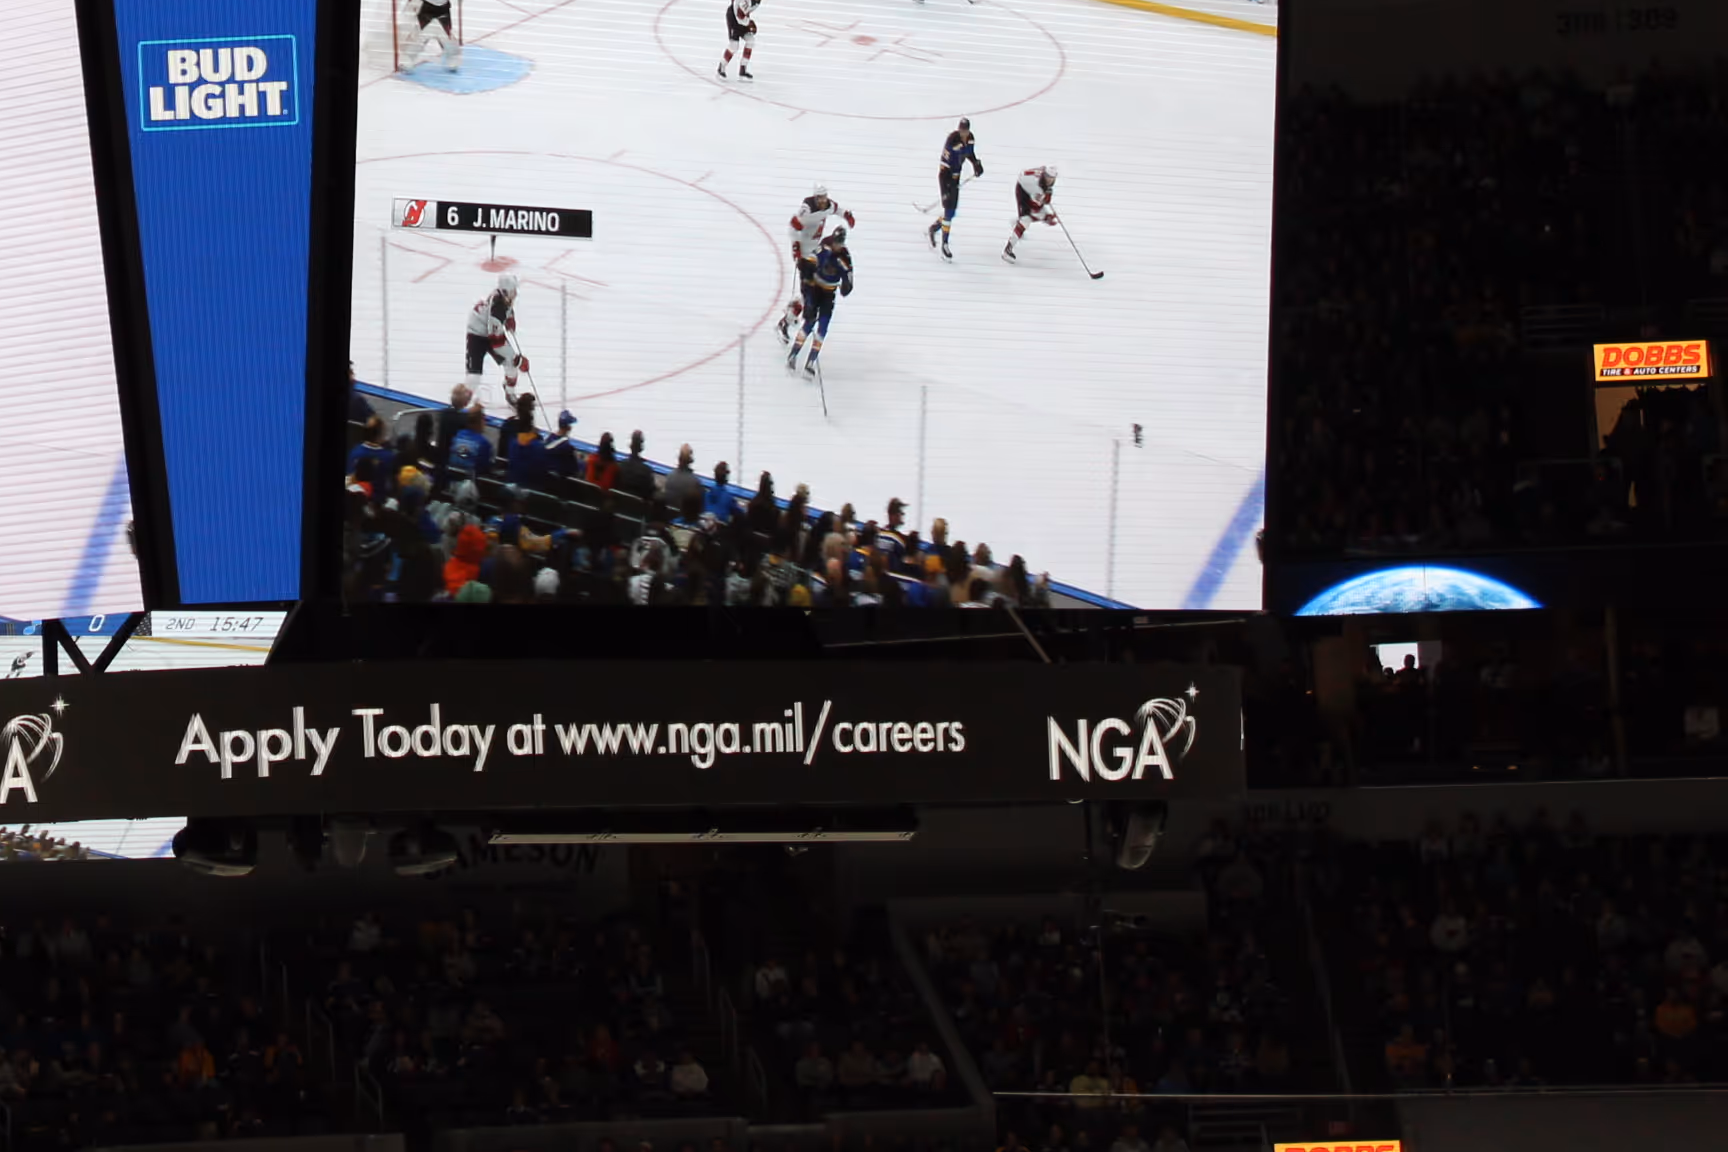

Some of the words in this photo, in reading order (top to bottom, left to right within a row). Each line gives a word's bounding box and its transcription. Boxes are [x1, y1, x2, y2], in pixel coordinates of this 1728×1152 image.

[167, 46, 268, 84] BUD
[149, 81, 288, 121] LIGHT
[446, 206, 459, 226] 6
[472, 208, 487, 228] J.
[489, 209, 560, 232] MARINO
[1602, 344, 1701, 368] DOBBS
[1633, 367, 1657, 375] AUTO
[1658, 365, 1698, 374] CENTERS
[89, 614, 105, 632] 0
[165, 617, 195, 631] 2ND
[209, 616, 264, 633] 15:47
[175, 706, 341, 779] Apply
[352, 703, 497, 773] Today
[507, 713, 546, 756] at
[555, 700, 966, 769] www.nga.mil/careers
[1048, 714, 1174, 781] NGA
